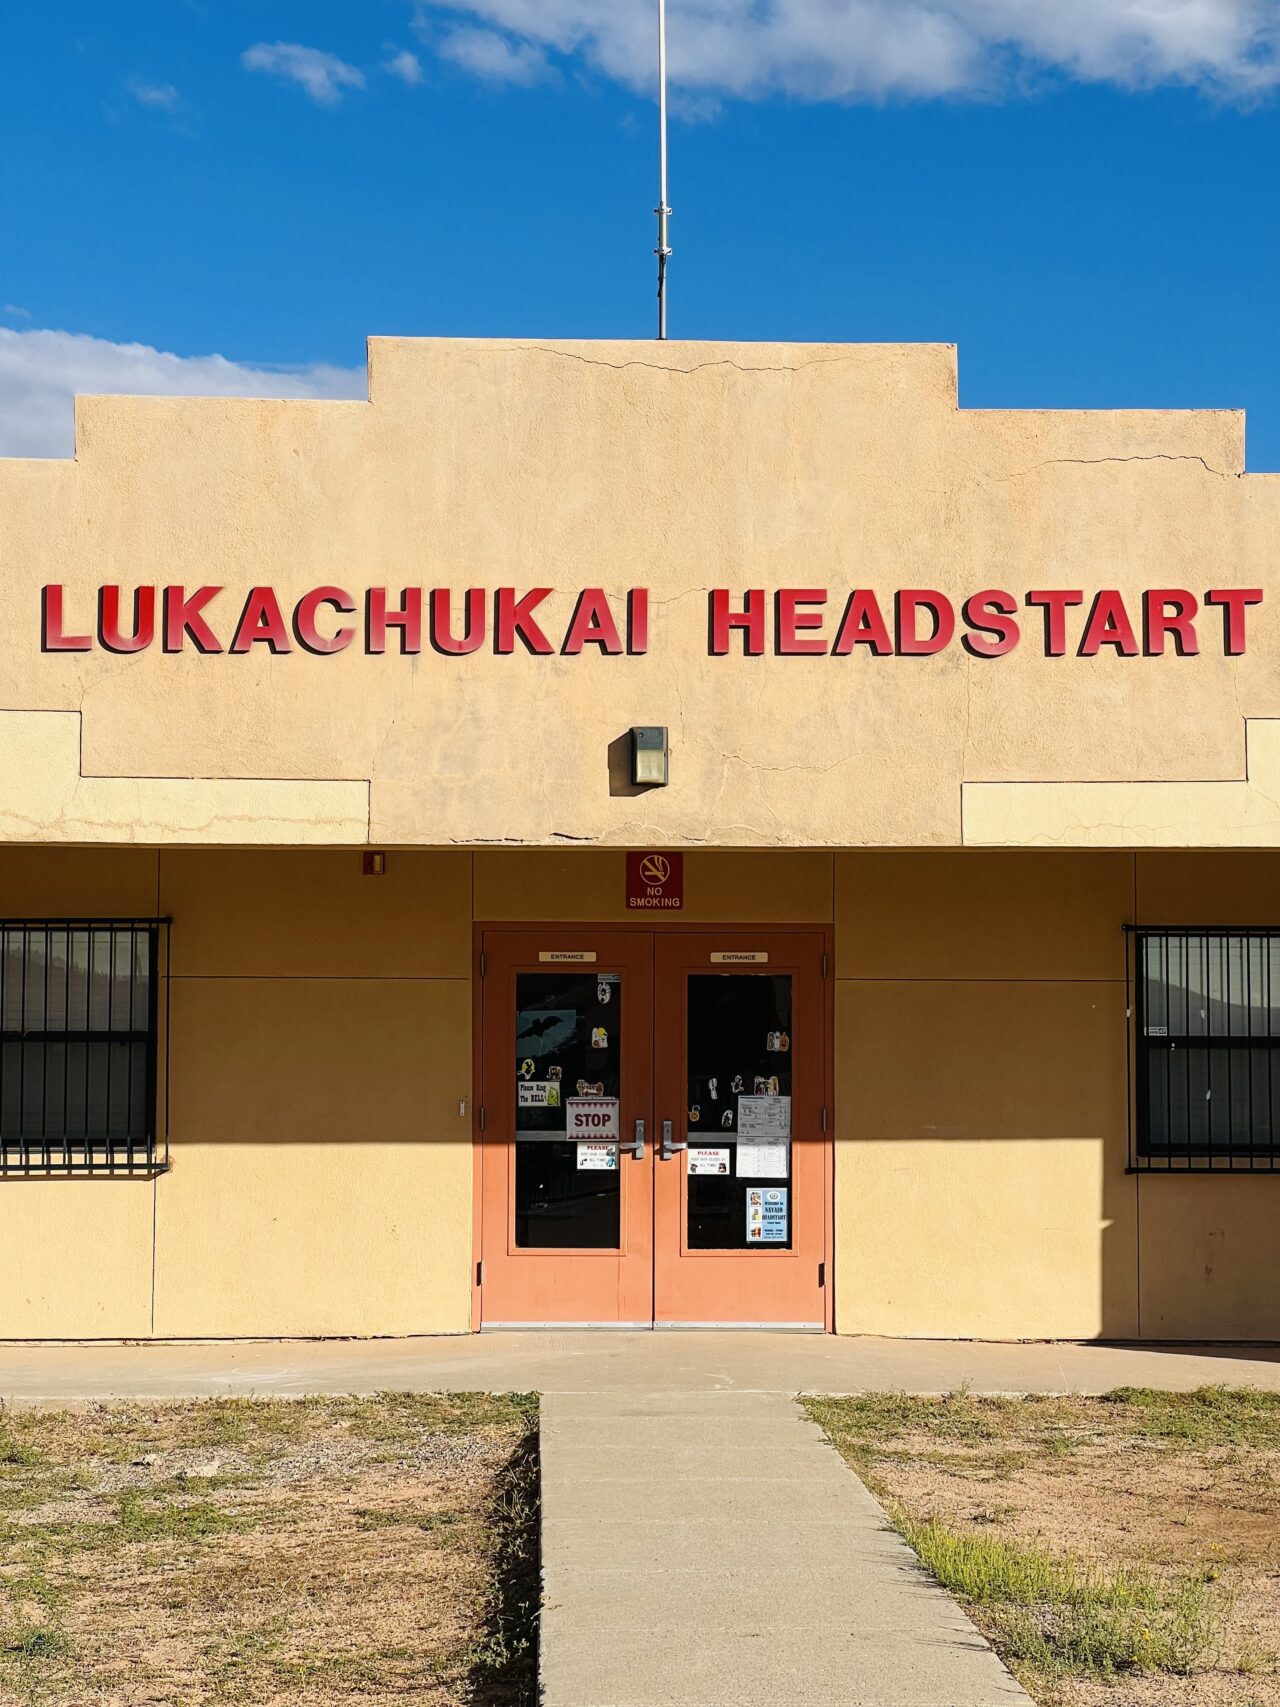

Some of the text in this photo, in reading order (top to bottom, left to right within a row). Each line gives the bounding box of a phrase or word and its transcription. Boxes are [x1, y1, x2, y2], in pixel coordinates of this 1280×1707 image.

[41, 584, 1264, 658] LUKACHUKAI HEADSTART
[647, 887, 662, 896] NO
[629, 897, 681, 907] SMOKING
[574, 1113, 611, 1127] STOP
